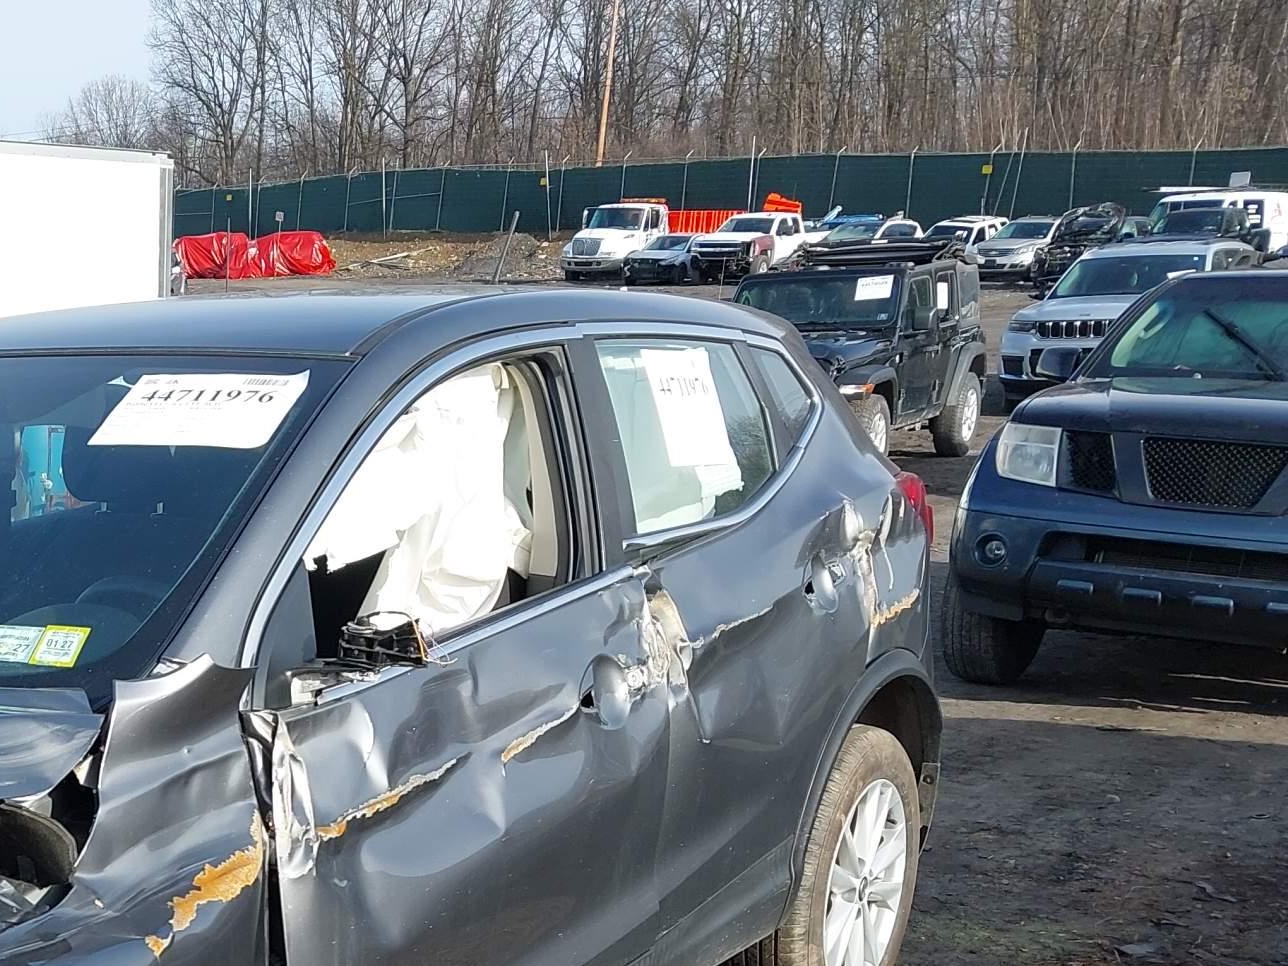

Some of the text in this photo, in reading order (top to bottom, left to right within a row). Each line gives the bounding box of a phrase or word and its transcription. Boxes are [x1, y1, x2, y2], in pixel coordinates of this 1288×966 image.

[141, 389, 278, 403] 44711976
[13, 643, 31, 653] 27
[46, 638, 74, 649] 01 27
